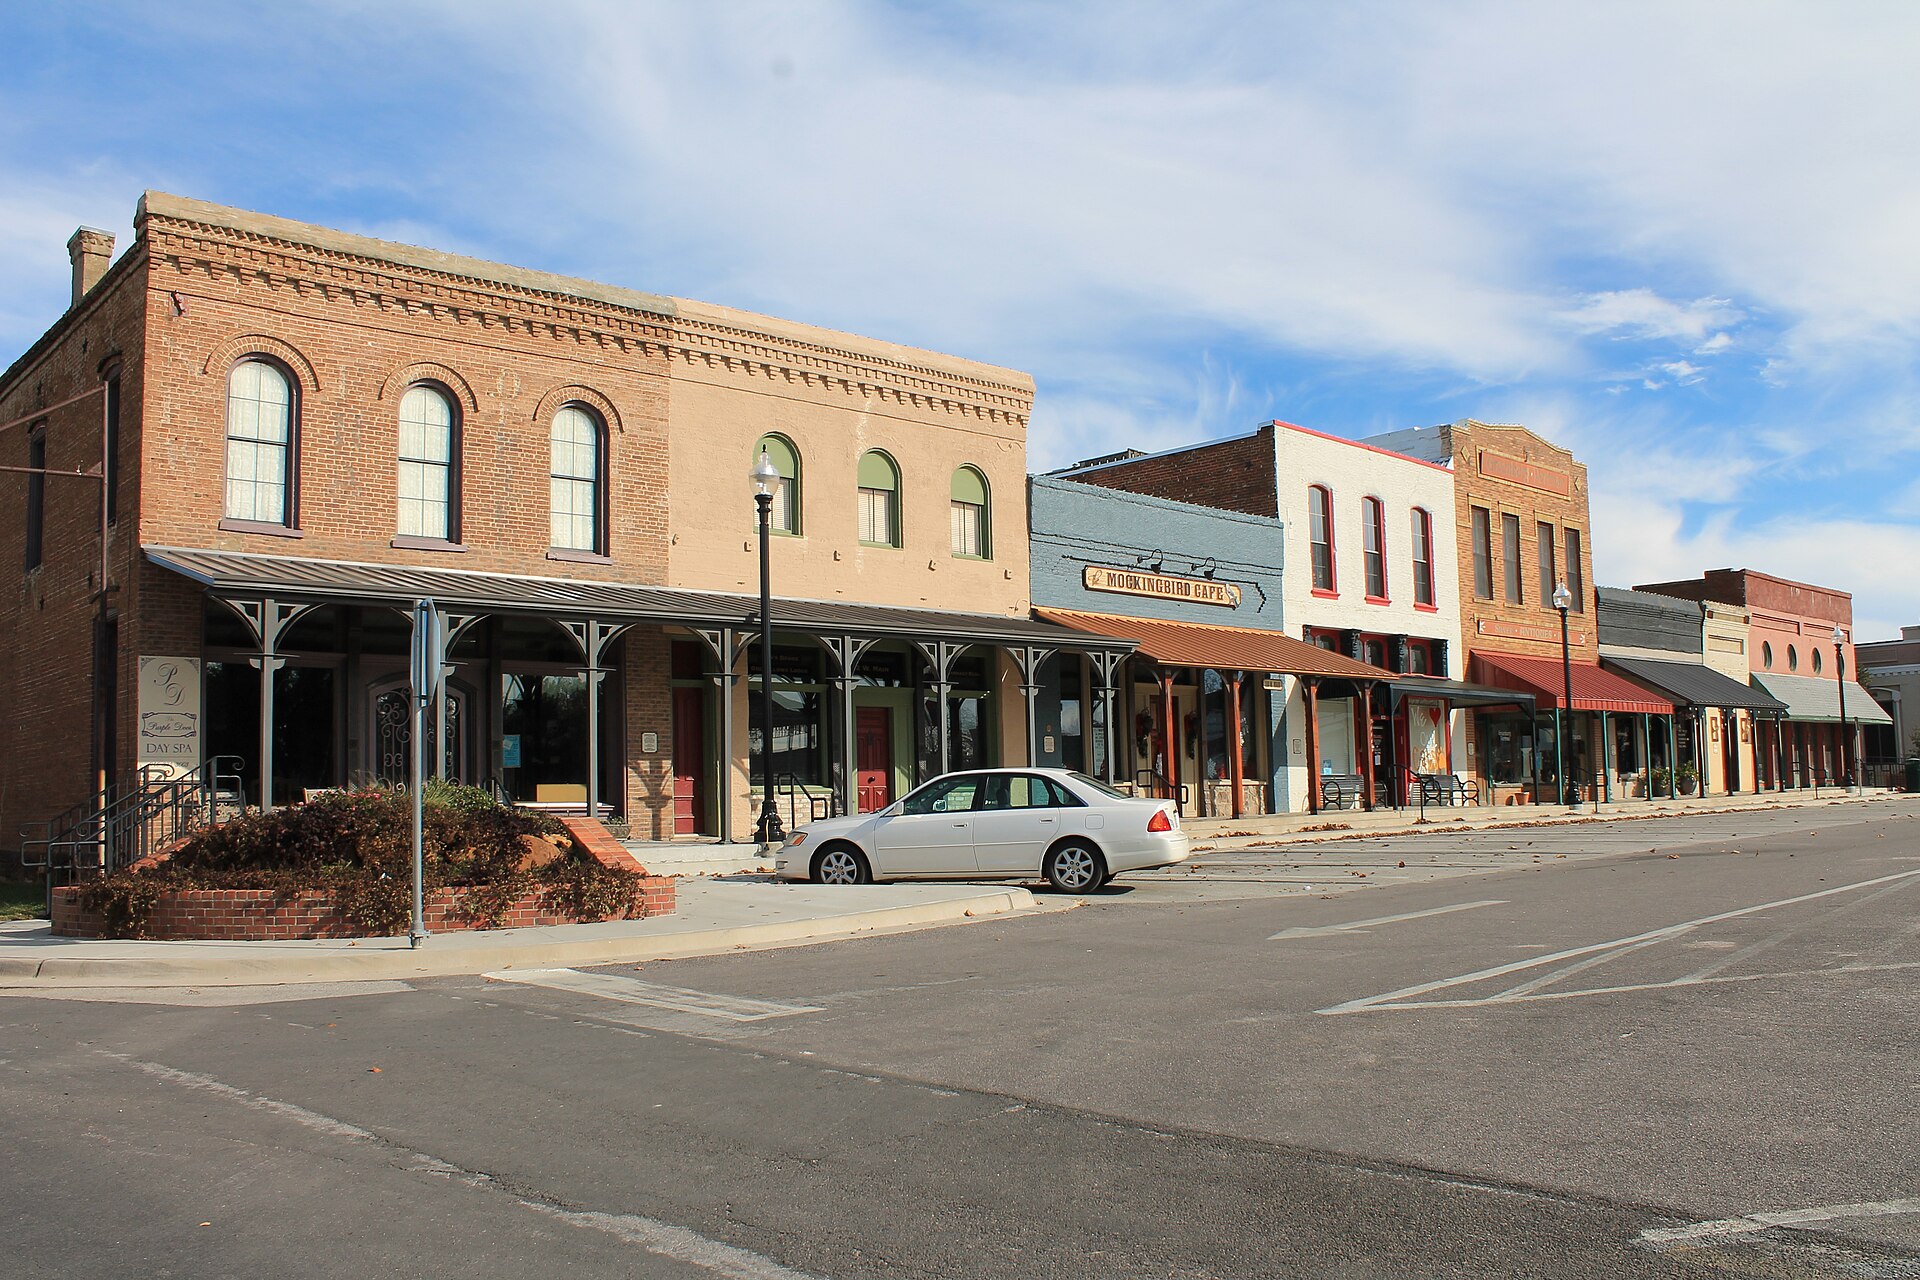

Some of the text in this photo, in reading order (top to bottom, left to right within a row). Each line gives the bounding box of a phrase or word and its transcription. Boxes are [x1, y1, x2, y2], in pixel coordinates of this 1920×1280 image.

[1106, 572, 1191, 597] MOCKINGBIRD
[1194, 584, 1224, 600] CAFE
[1519, 626, 1553, 640] ANTIQUES
[154, 663, 178, 687] P
[146, 721, 171, 733] Purple
[146, 743, 192, 753] DAY SPA
